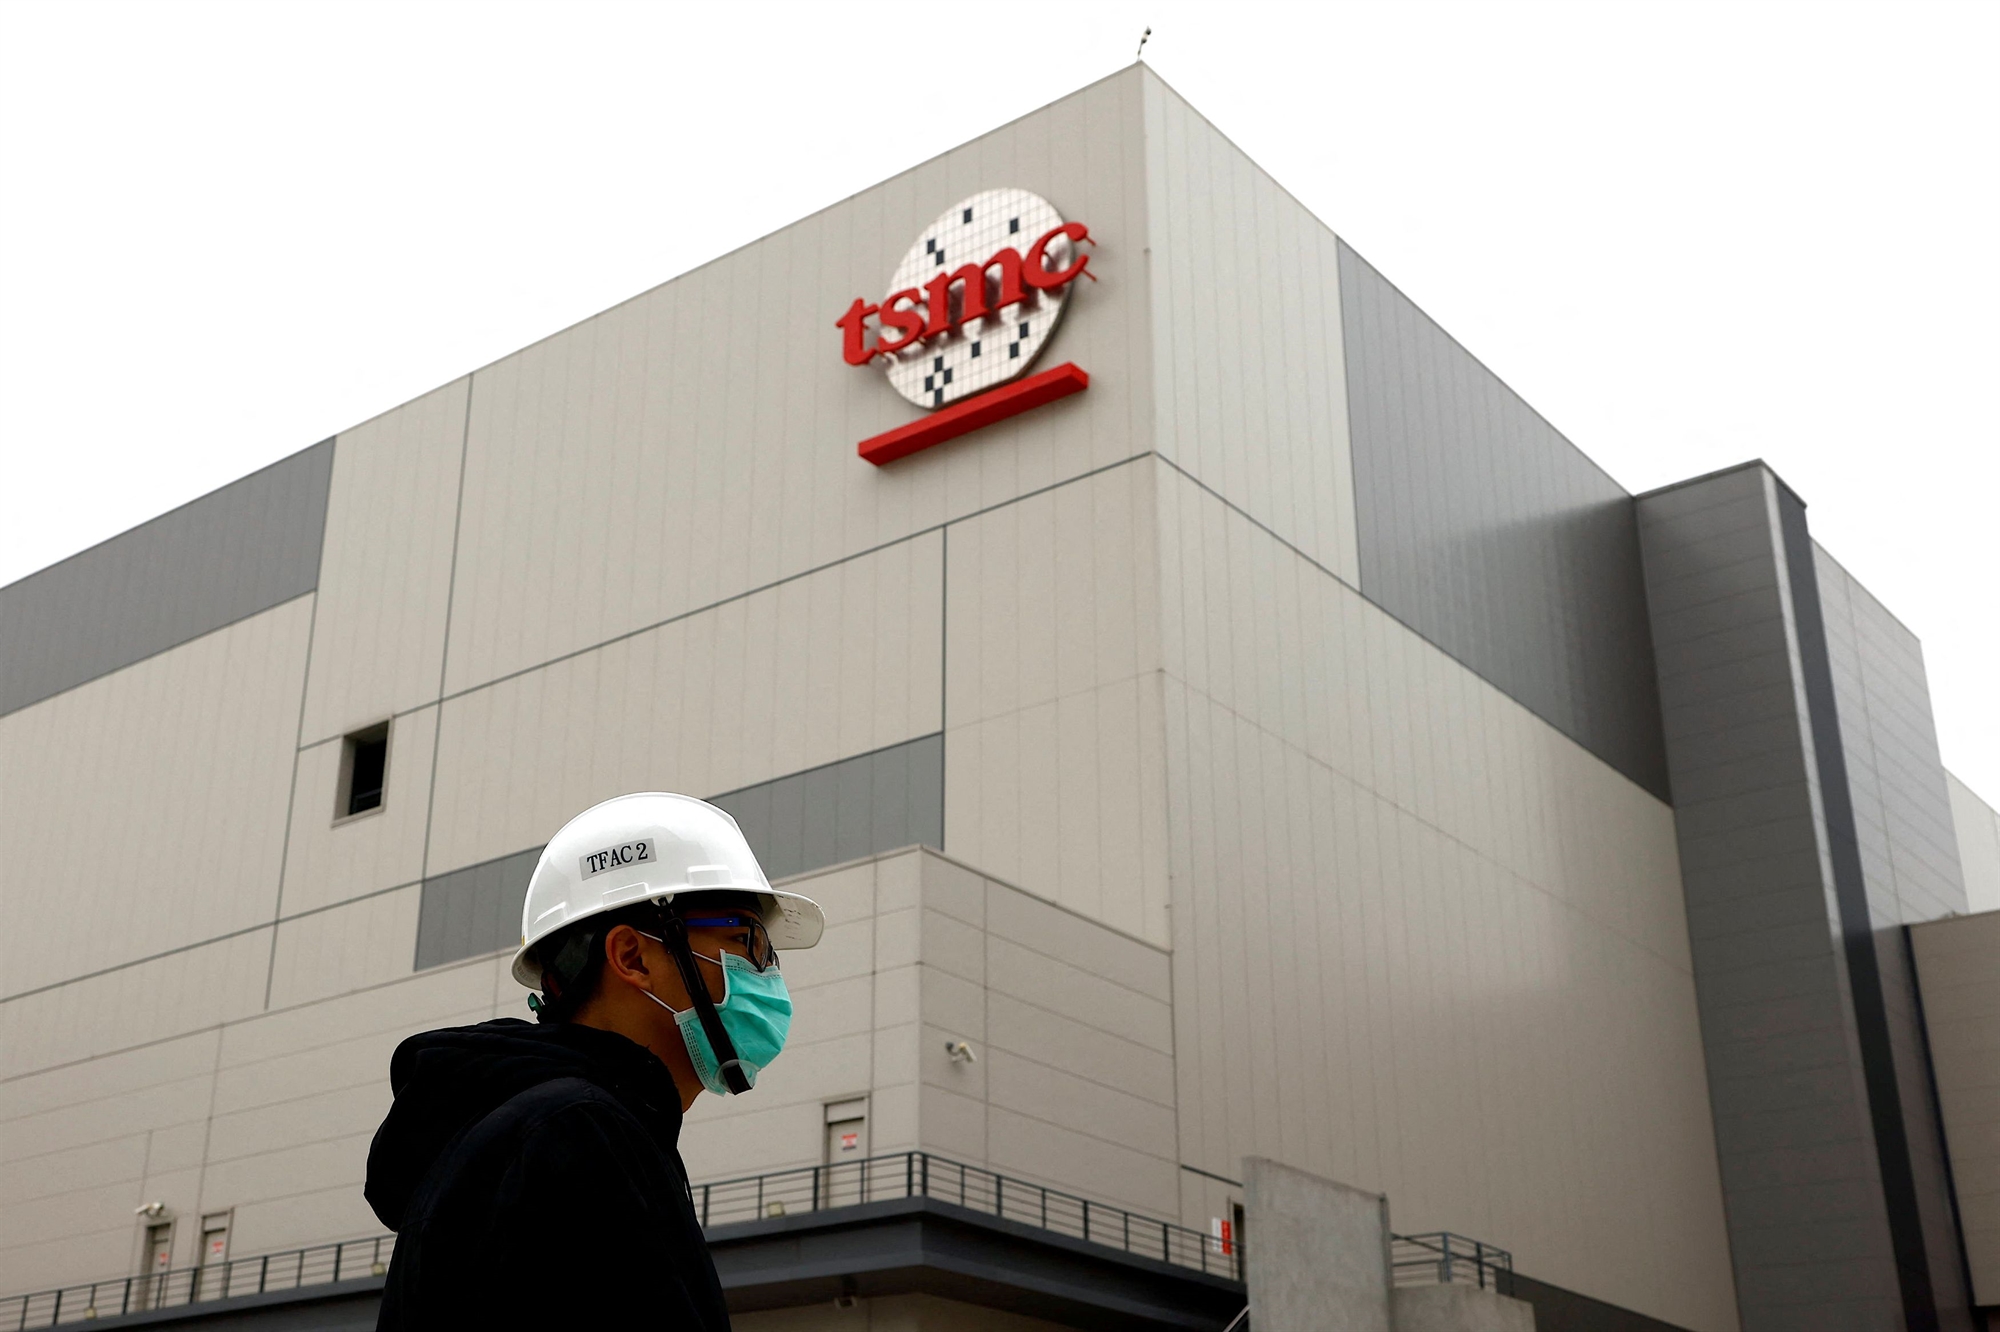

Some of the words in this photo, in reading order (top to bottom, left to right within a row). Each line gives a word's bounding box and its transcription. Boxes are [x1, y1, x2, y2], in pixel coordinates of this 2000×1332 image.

[835, 222, 1089, 367] tsmc
[586, 845, 633, 873] TFAC
[636, 842, 648, 860] 2
